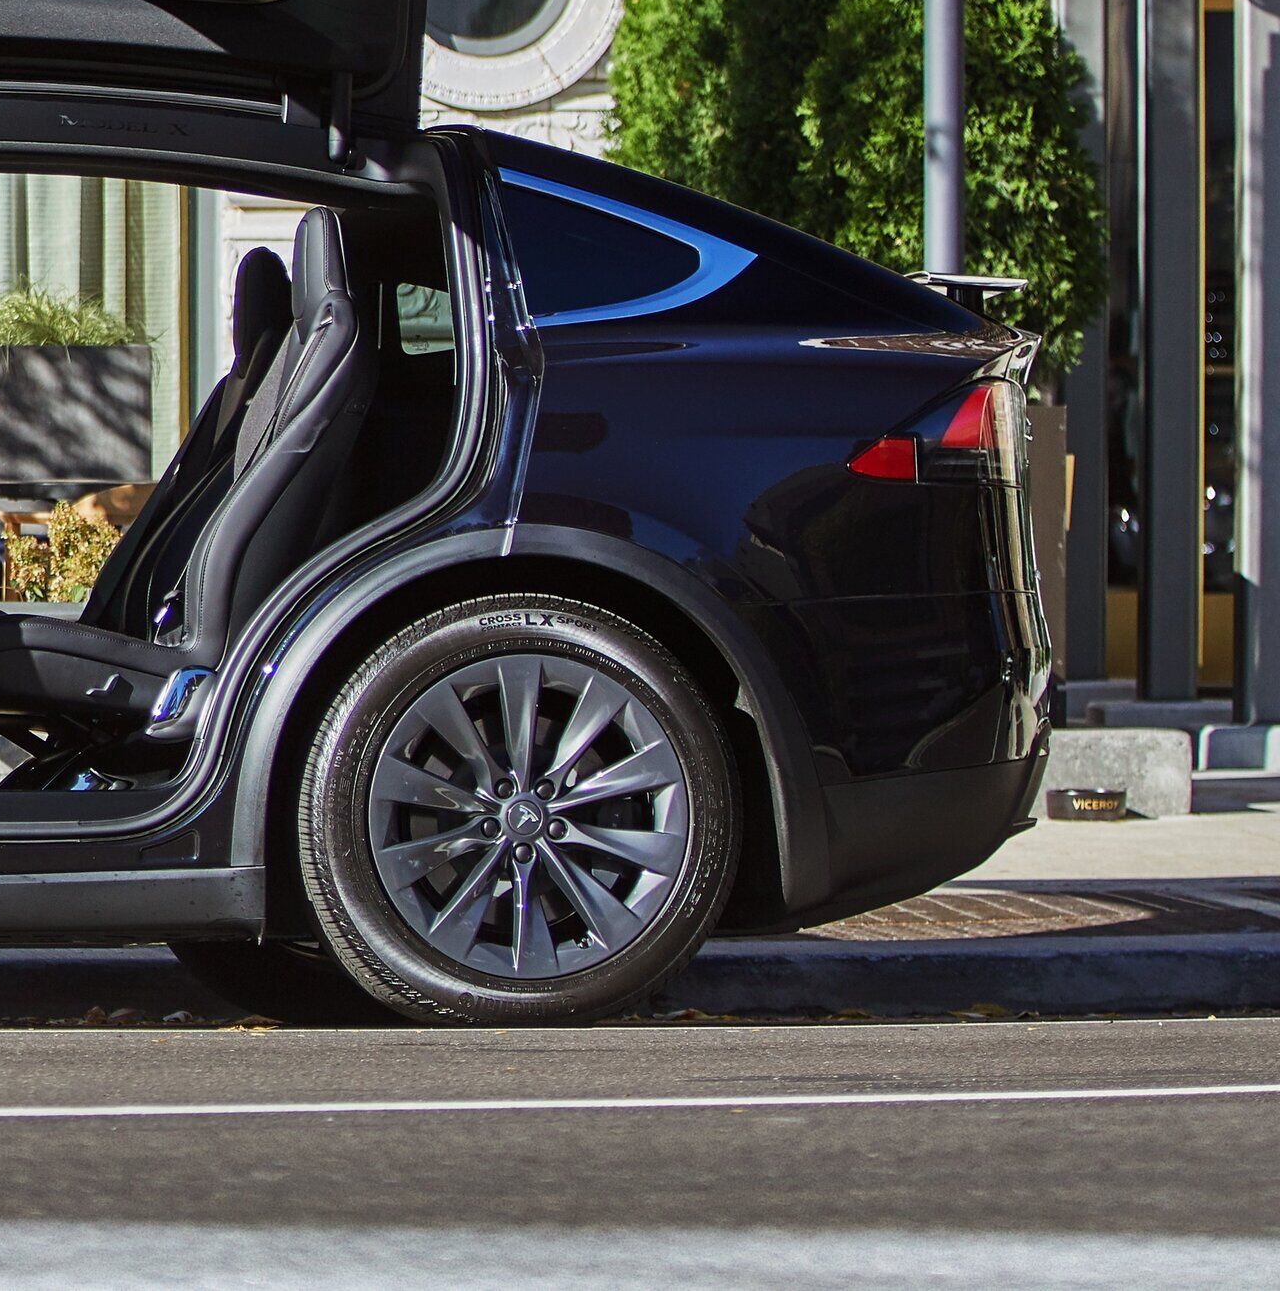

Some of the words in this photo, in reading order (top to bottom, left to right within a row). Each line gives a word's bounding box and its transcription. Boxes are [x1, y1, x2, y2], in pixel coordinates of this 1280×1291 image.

[478, 613, 522, 627] CROSS
[524, 613, 554, 627] LX
[556, 615, 598, 632] SPORT
[480, 622, 522, 632] CONTACT
[1072, 797, 1119, 811] VICEROY
